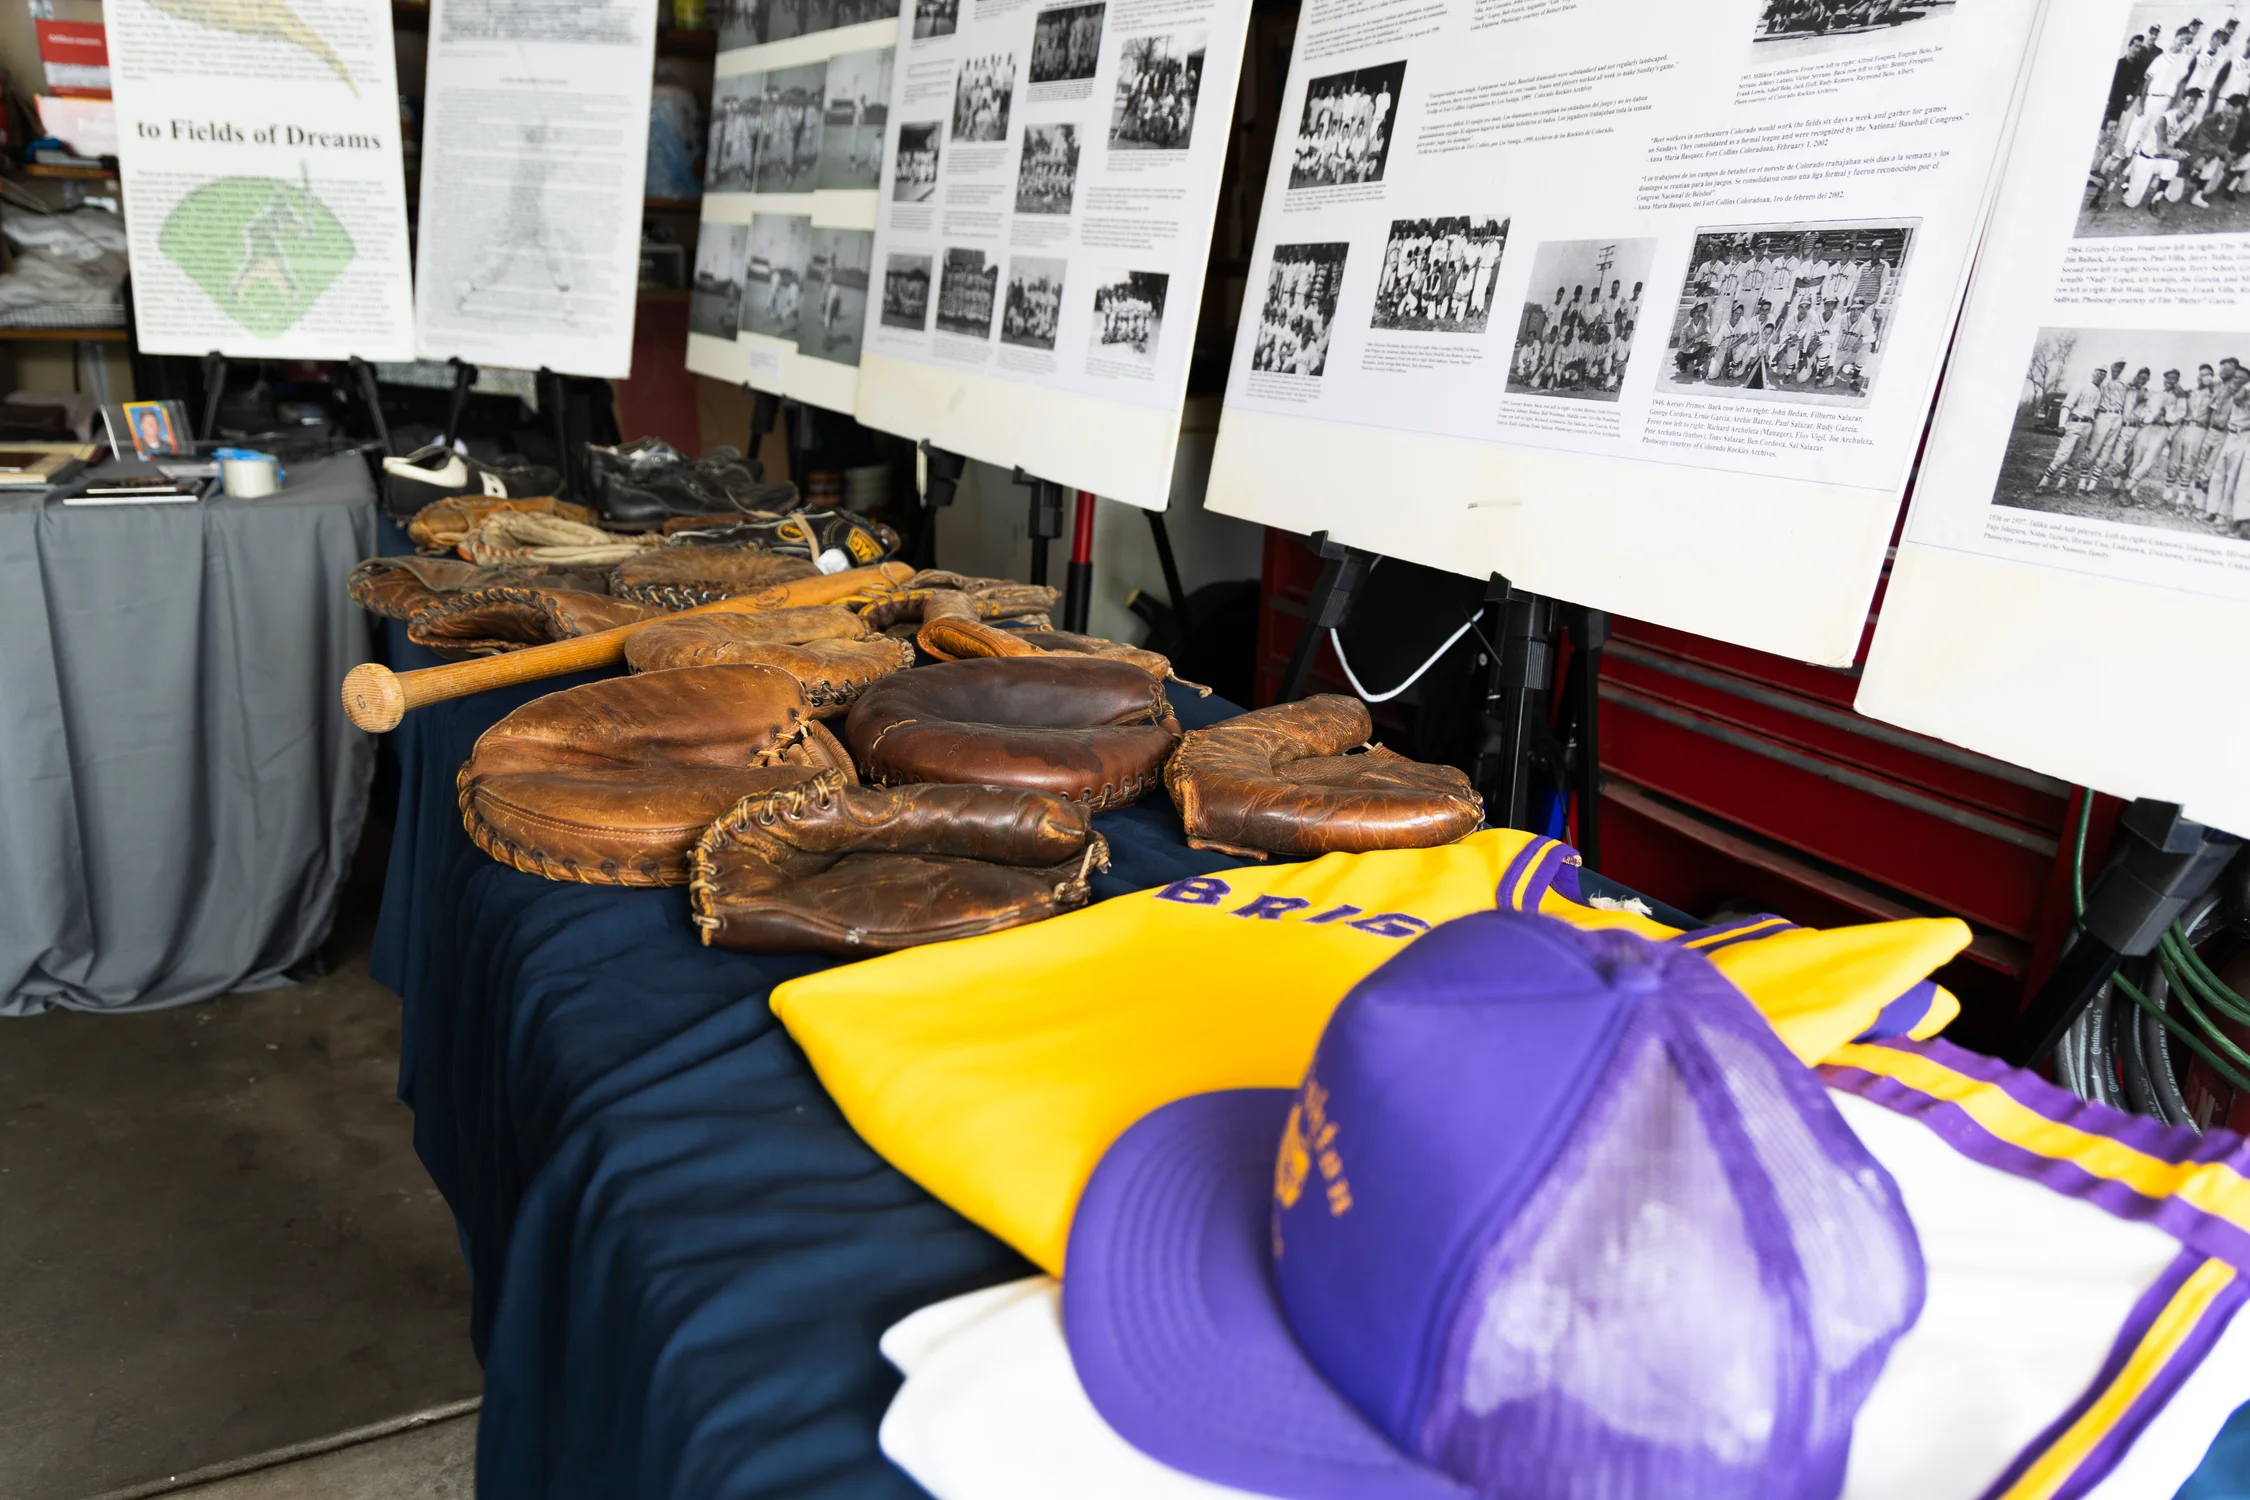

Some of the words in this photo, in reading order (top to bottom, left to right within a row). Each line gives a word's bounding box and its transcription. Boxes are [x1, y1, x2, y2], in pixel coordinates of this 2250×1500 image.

[1693, 130, 1729, 138] northeastern
[1729, 126, 1756, 134] Colorado
[1757, 123, 1776, 131] would
[1873, 111, 1887, 119] and
[1887, 110, 1910, 119] gather
[1923, 106, 1946, 115] games
[1693, 139, 1728, 148] consolidated
[1740, 135, 1760, 143] formal
[1810, 126, 1844, 136] recognized
[1868, 121, 1896, 130] National
[1898, 117, 1928, 127] Baseball
[137, 121, 161, 139] to
[170, 118, 245, 143] Fields
[252, 123, 277, 145] of
[286, 124, 382, 150] Dreams
[1718, 148, 1738, 156] Collins
[1739, 145, 1774, 154] Coloradoan,
[1813, 138, 1828, 147] 2002
[1726, 167, 1748, 175] betabel
[1795, 160, 1824, 169] Colorado
[1825, 158, 1861, 167] trabajaban
[1666, 399, 1684, 407] Kersey
[1837, 414, 1862, 422] Salazar,
[1641, 436, 1668, 446] Photocopy
[1699, 443, 1725, 451] Colorado
[1726, 445, 1748, 454] Rockies
[1751, 449, 1776, 457] Archives.
